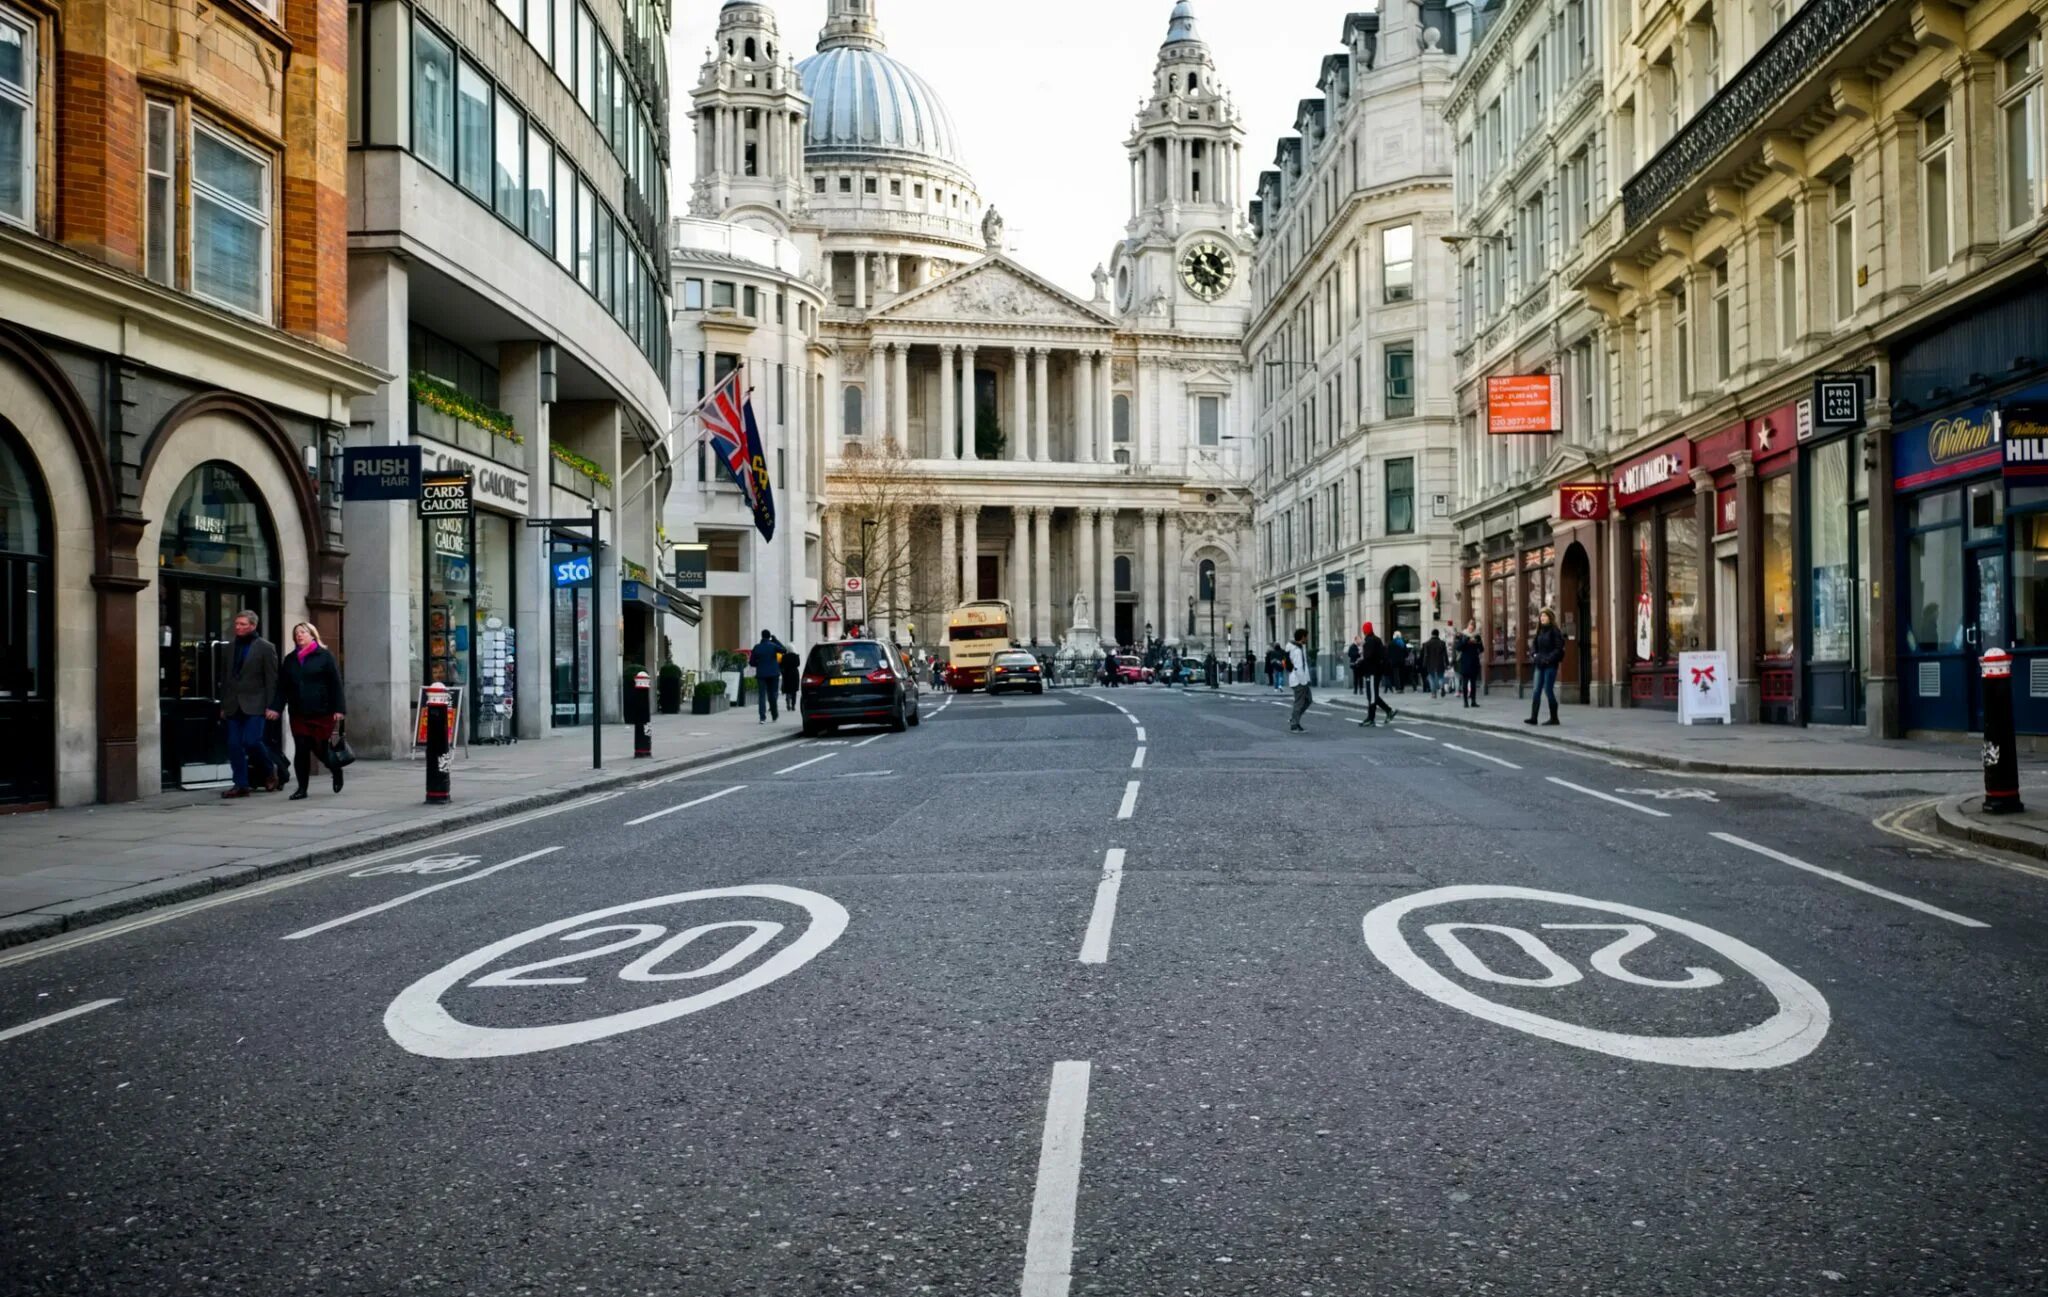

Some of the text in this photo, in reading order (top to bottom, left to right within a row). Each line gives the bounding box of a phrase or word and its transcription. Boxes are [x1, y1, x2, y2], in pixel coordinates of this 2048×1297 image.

[1828, 389, 1851, 398] PRO
[1828, 399, 1851, 407] ATH
[1829, 408, 1851, 416] LON
[1930, 414, 1992, 463] William
[353, 458, 409, 477] RUSH
[381, 476, 410, 487] HAIR
[479, 467, 518, 502] GALORE
[424, 486, 465, 498] CARDS
[421, 498, 468, 511] GALORE
[195, 515, 226, 534] RUSH
[437, 518, 462, 534] CARDS
[435, 532, 464, 552] GALORE
[467, 920, 785, 988] 20
[1423, 921, 1725, 989] 20
